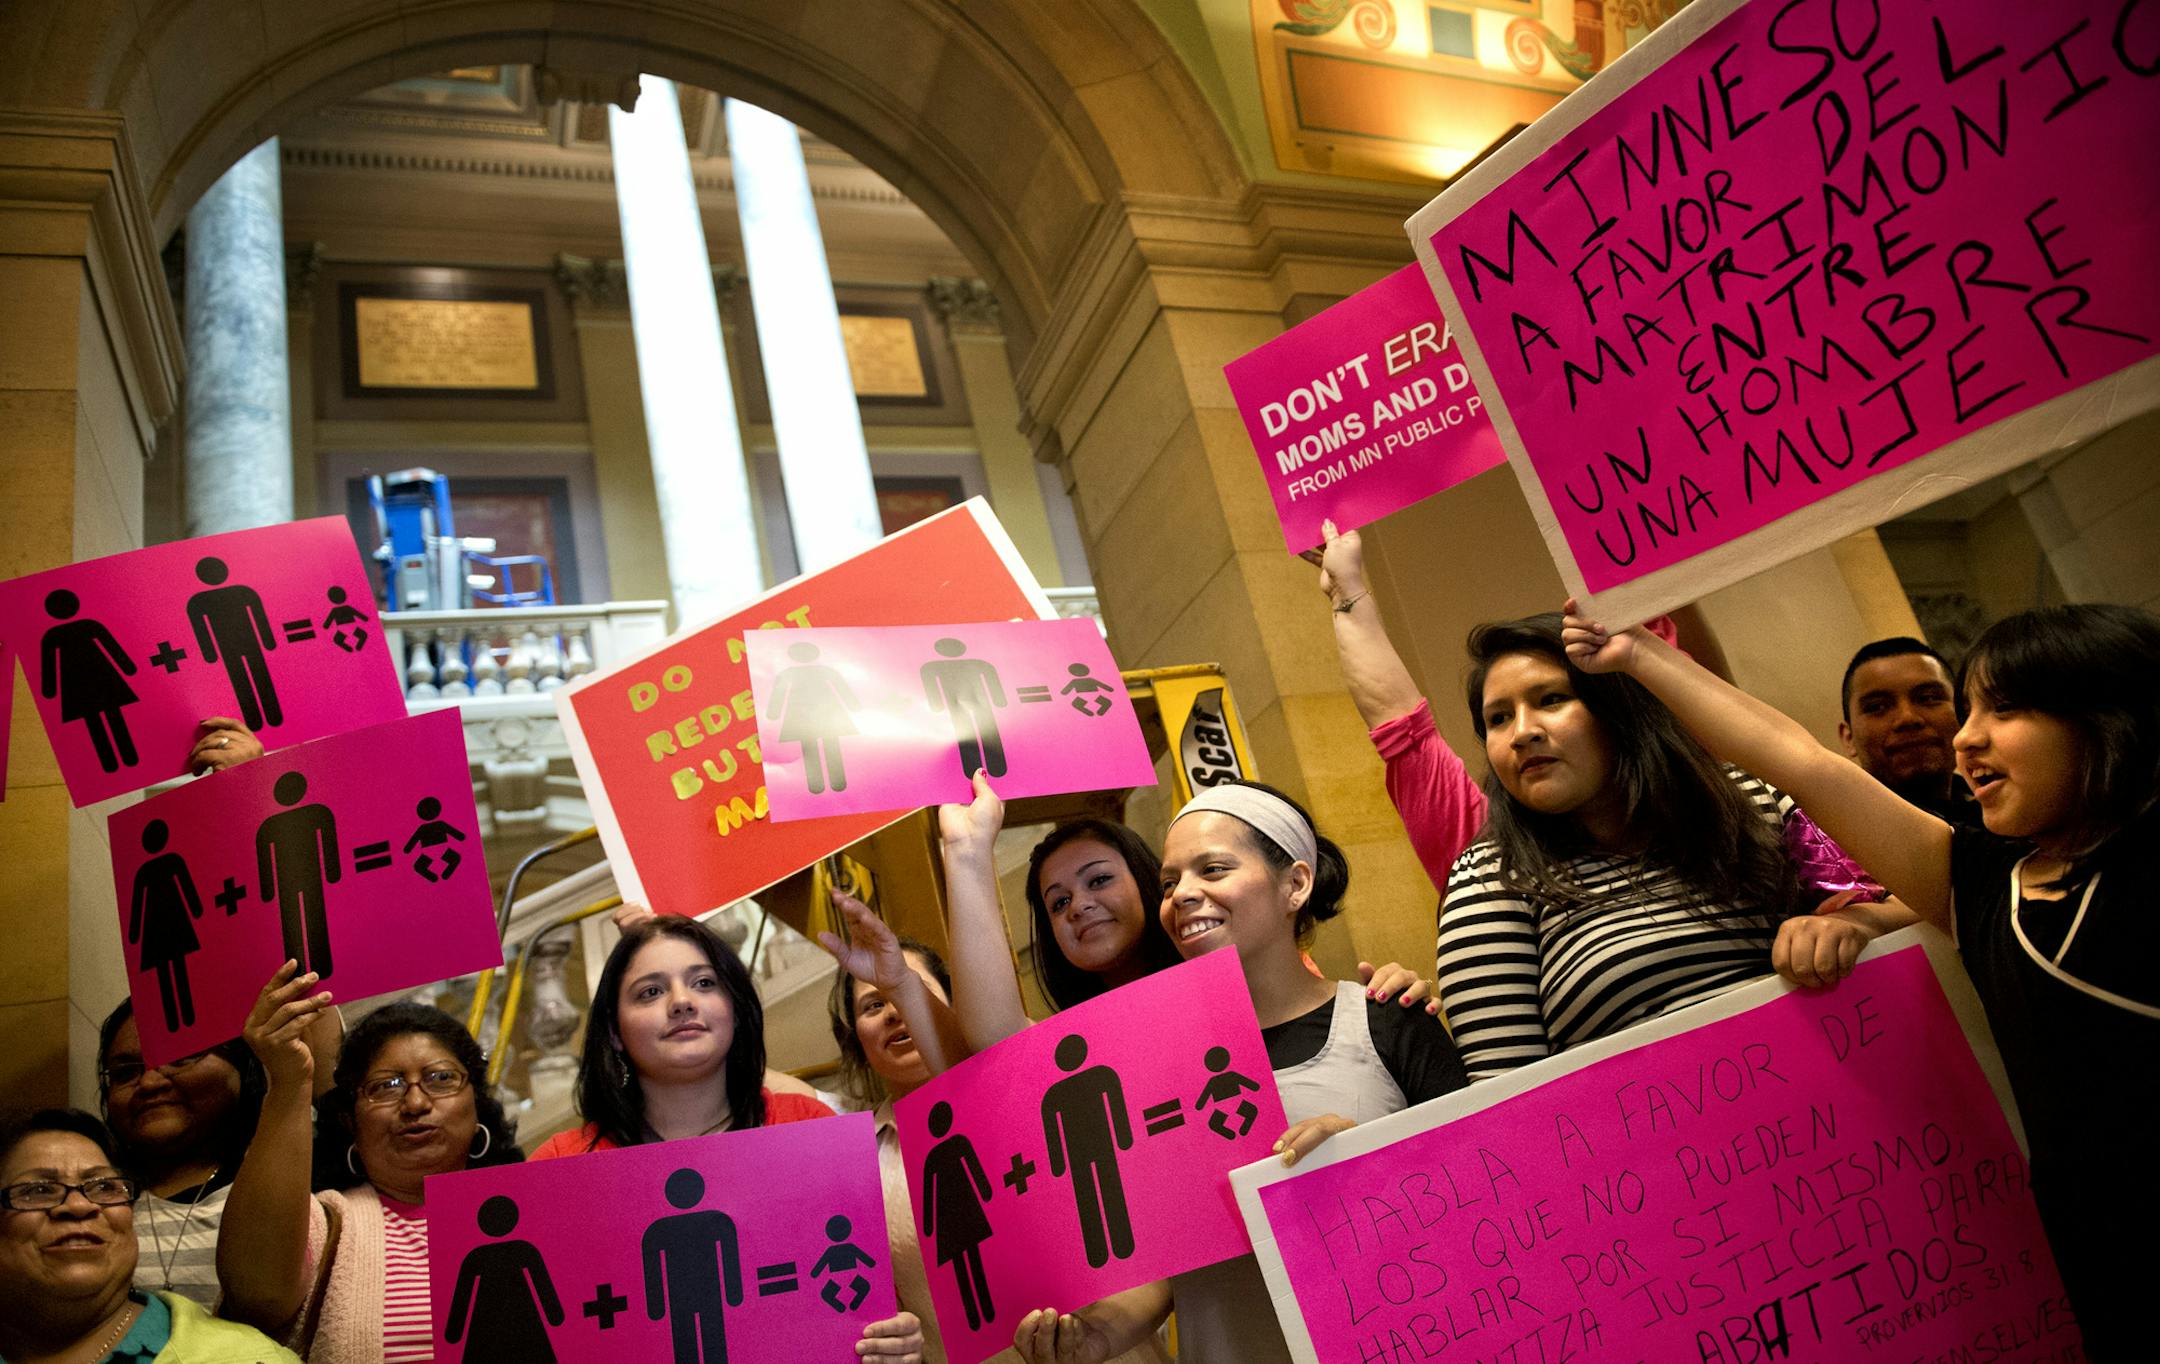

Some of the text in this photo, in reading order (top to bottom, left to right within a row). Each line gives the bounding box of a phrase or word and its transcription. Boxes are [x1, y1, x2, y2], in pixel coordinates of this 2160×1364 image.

[1510, 15, 2006, 374] A FAVOR DEL
[1564, 198, 2093, 516] UN HOMBRE
[1678, 203, 1936, 396] ENTRE
[1259, 352, 1370, 438] DON'T
[1275, 412, 1366, 476] MOMS
[1373, 377, 1438, 430] AND
[1287, 459, 1348, 502] FROM
[1349, 442, 1383, 473] MN
[1383, 404, 1464, 455] PUBLIC
[1595, 285, 2151, 567] UNA MUJER
[628, 604, 812, 713] DO NT
[671, 732, 763, 801] BUT
[1304, 995, 1884, 1271] HABLA A FAVOR DE
[1341, 1103, 1837, 1327] LOS QUE NO PUEDEN
[1356, 1275, 1545, 1364] HABLAR
[1561, 1239, 1647, 1304] POR
[1672, 1200, 1741, 1259] SI
[1621, 1196, 1893, 1329] JUSTICIA
[1919, 1151, 2027, 1233] PARA
[1696, 1223, 1988, 1364] ABATIDOS
[1854, 1281, 1975, 1352] PROVERVIOS
